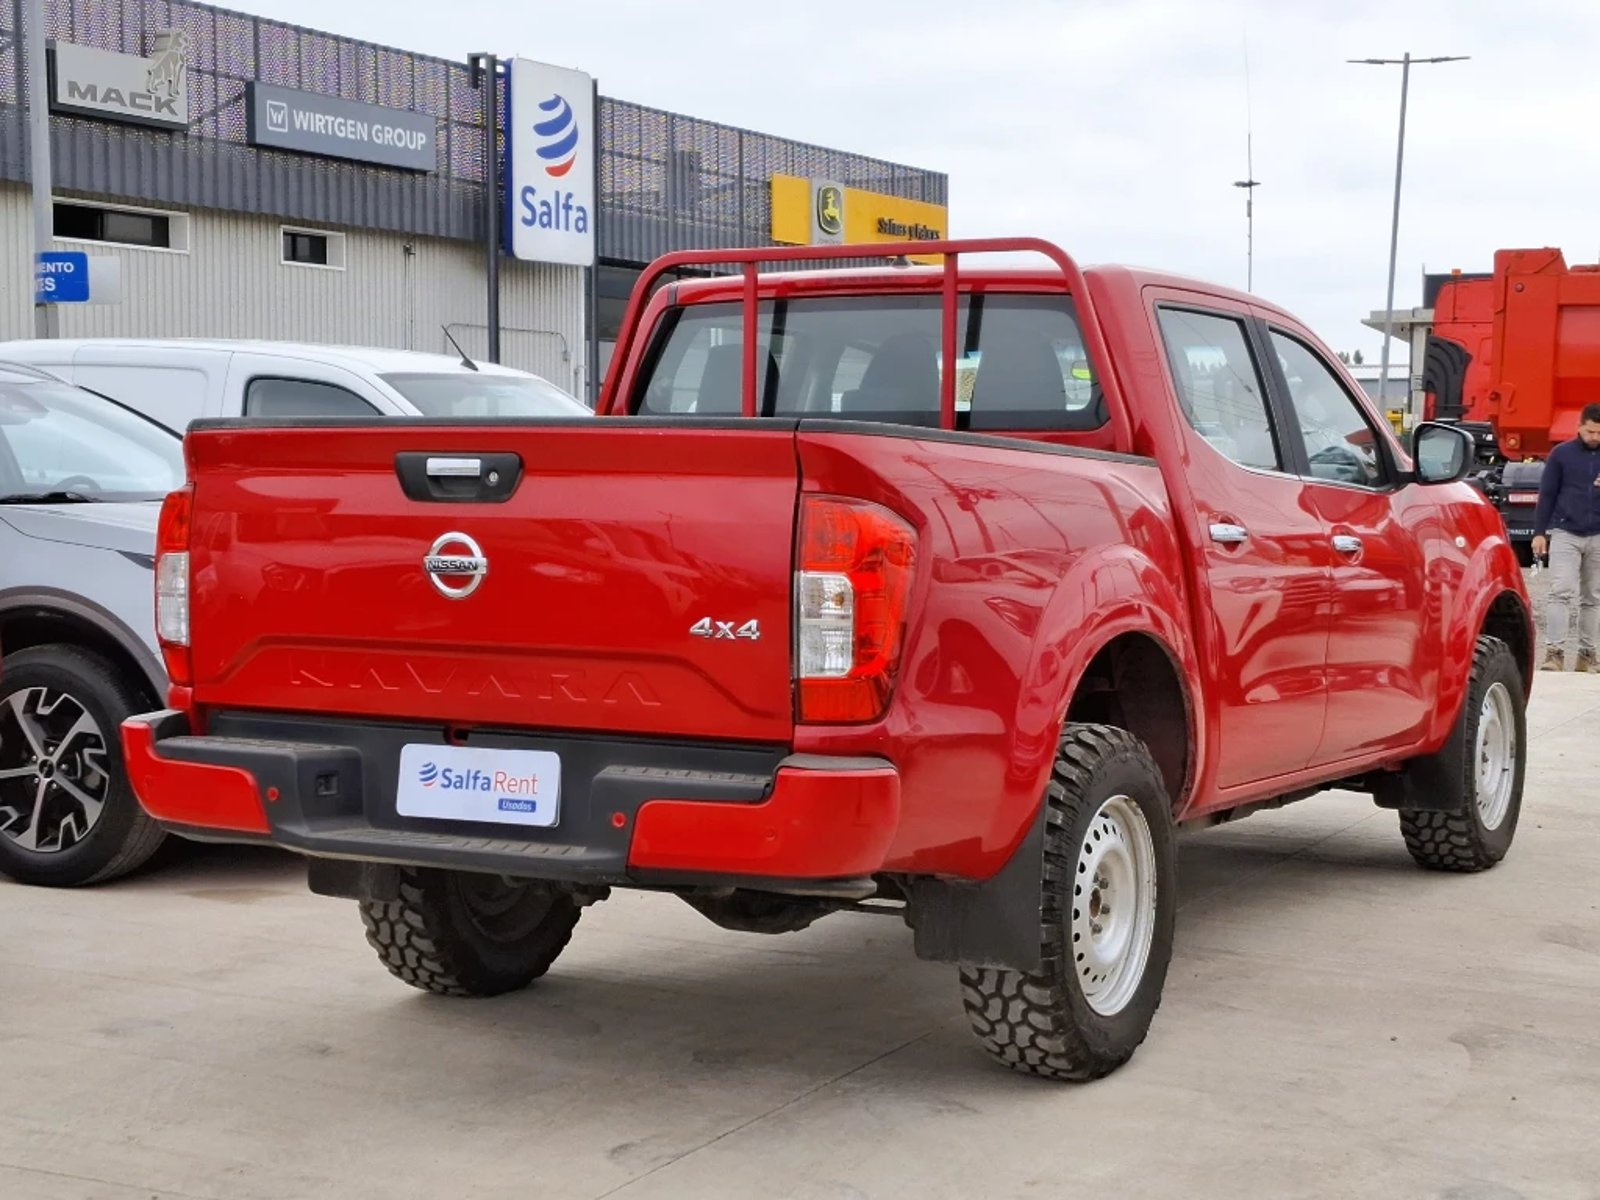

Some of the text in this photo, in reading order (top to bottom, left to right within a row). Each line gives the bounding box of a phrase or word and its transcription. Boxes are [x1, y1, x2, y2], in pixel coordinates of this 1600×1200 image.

[67, 80, 178, 116] MACK
[293, 109, 368, 142] WIRTGEN
[371, 123, 427, 151] GROUP
[520, 184, 588, 234] Salfa
[427, 559, 479, 571] NISSAN
[689, 616, 761, 640] 4x4
[289, 654, 662, 706] NAVARA
